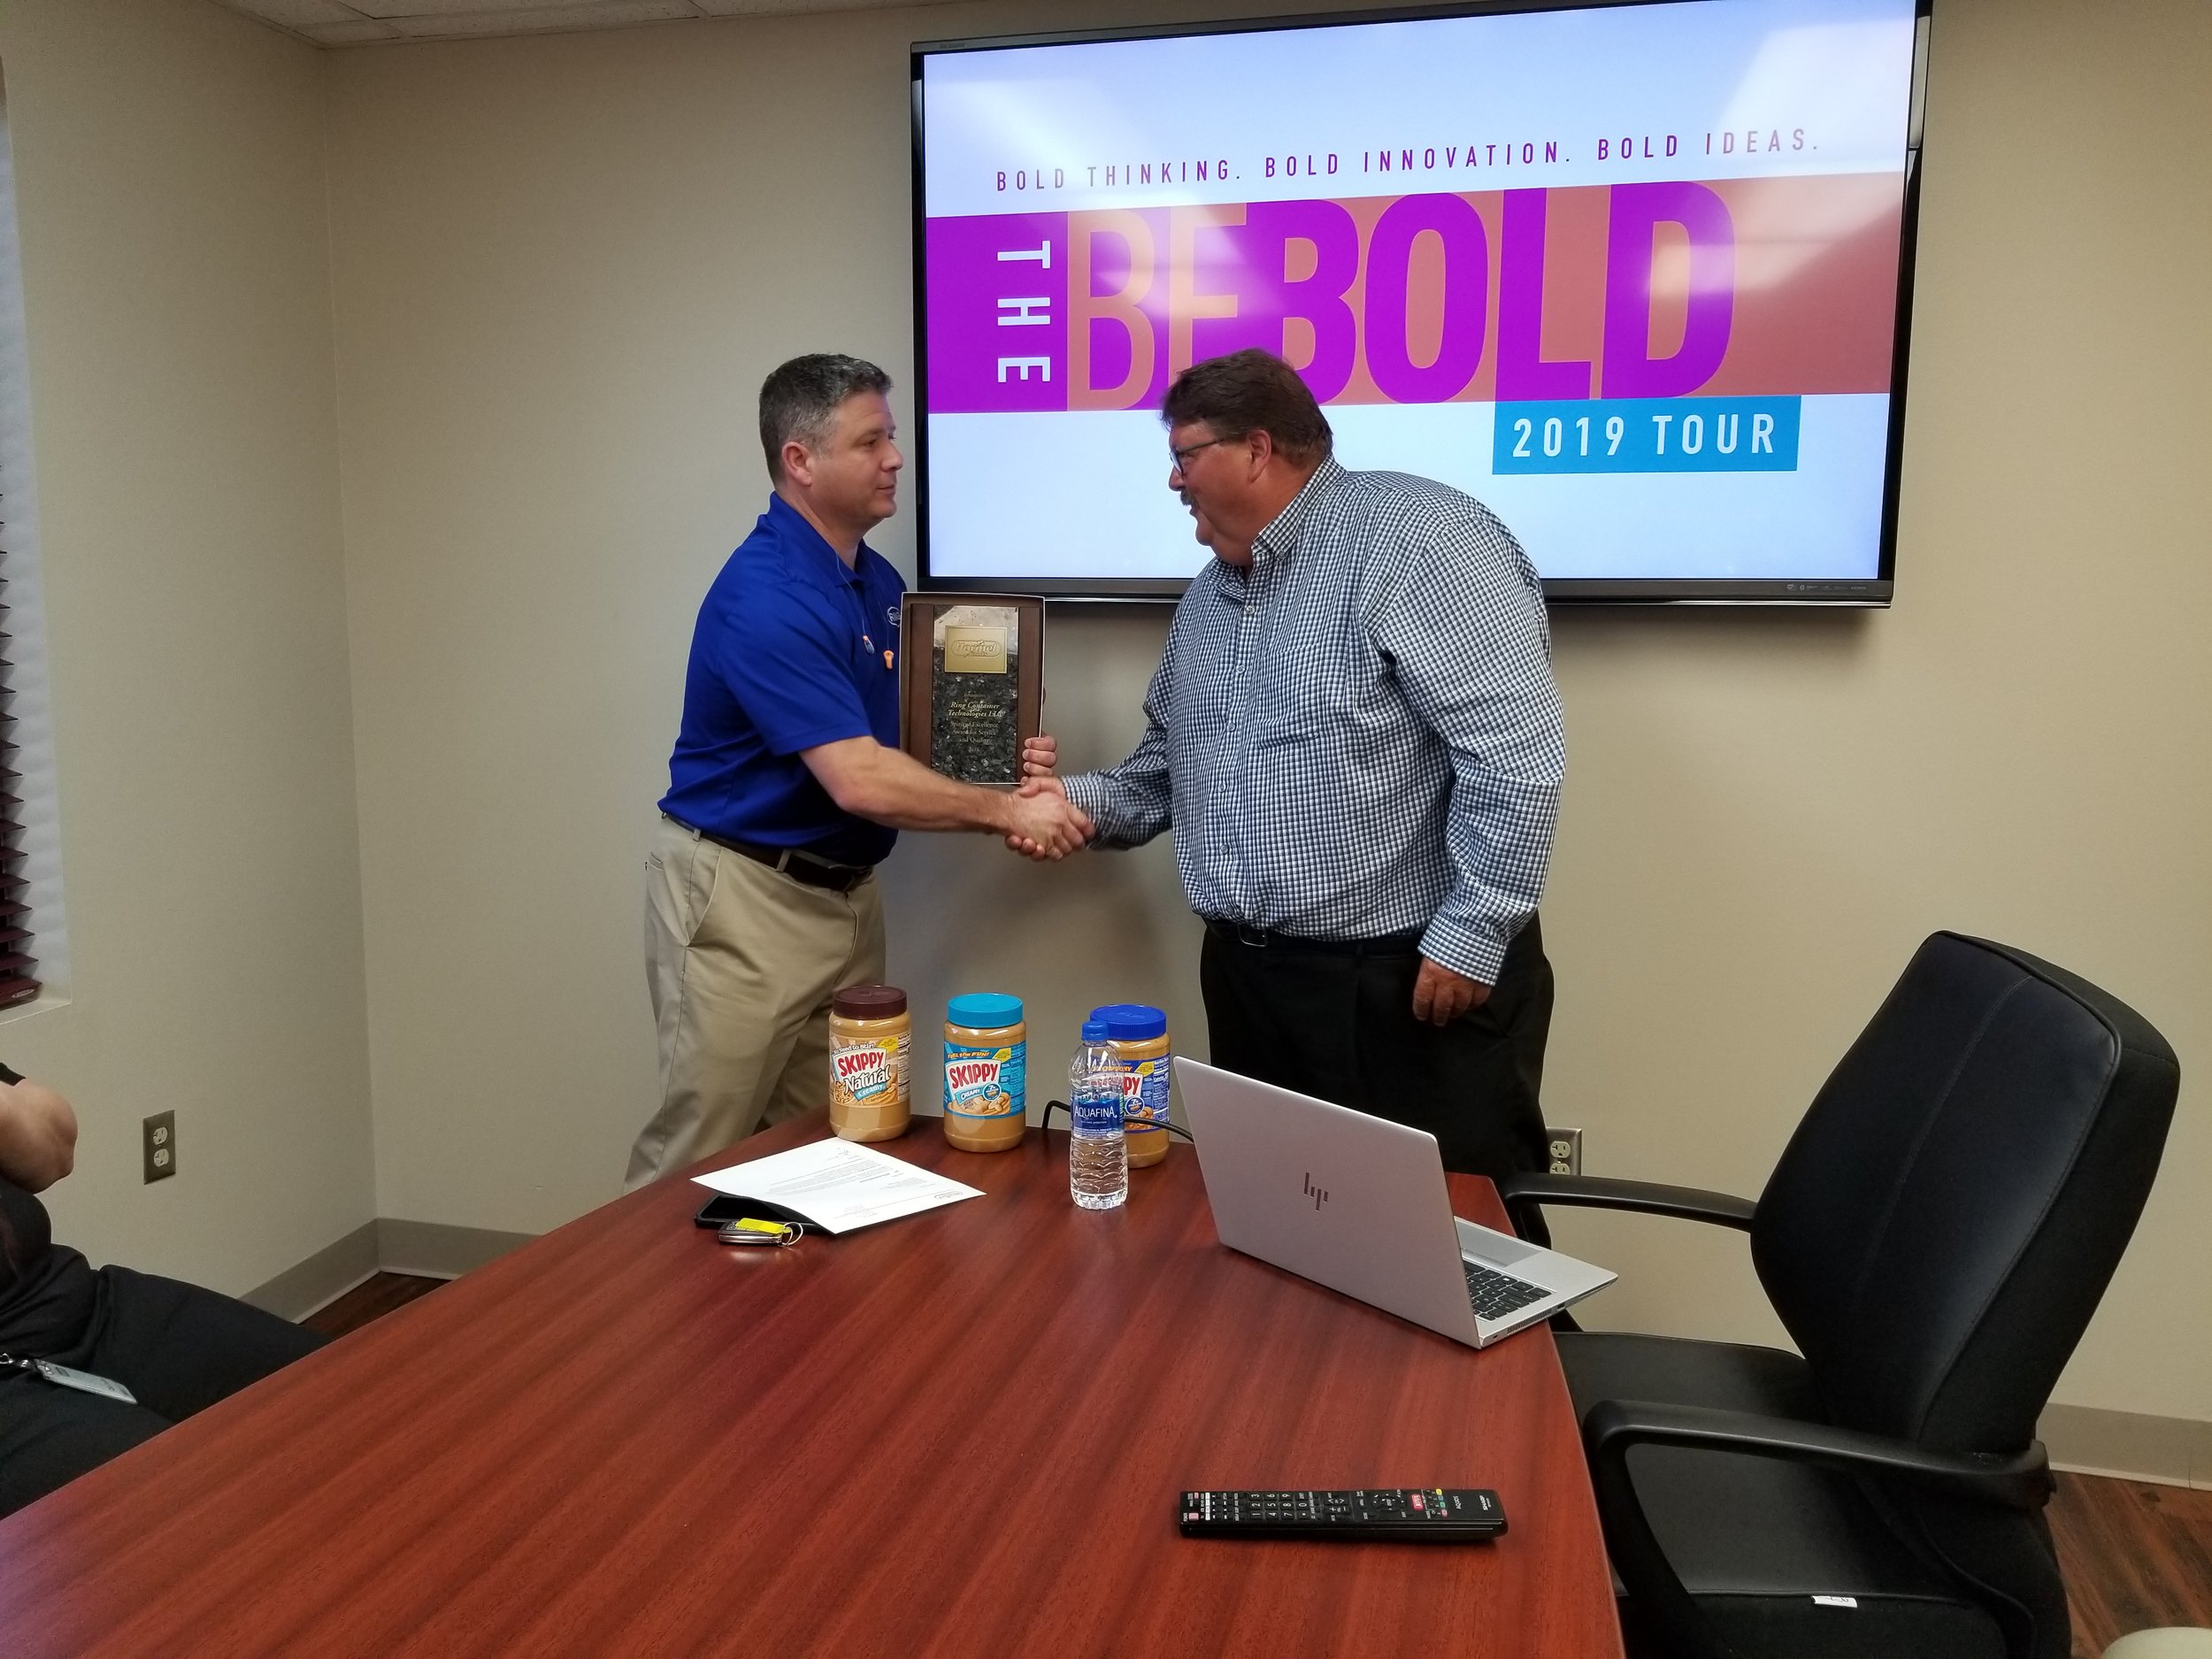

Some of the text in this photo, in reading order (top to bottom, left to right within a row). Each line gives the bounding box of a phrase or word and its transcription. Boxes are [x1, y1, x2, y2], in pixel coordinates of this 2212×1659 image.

[996, 127, 1818, 192] BOLD THINKING. BOLD INNOVATION. BOLD IDEAS.
[996, 240, 1051, 383] THE
[1512, 412, 1776, 458] 2019 TOUR
[948, 710, 987, 718] Technologies
[950, 702, 966, 710] Ring
[837, 1051, 884, 1078] SKIPPY
[843, 1064, 891, 1094] Natural
[949, 1063, 999, 1089] SKIPPY
[857, 1084, 883, 1097] Creamy
[1074, 1105, 1116, 1119] AQUAFINA
[1452, 1495, 1462, 1510] AQUOS
[1479, 1494, 1488, 1511] SHARP
